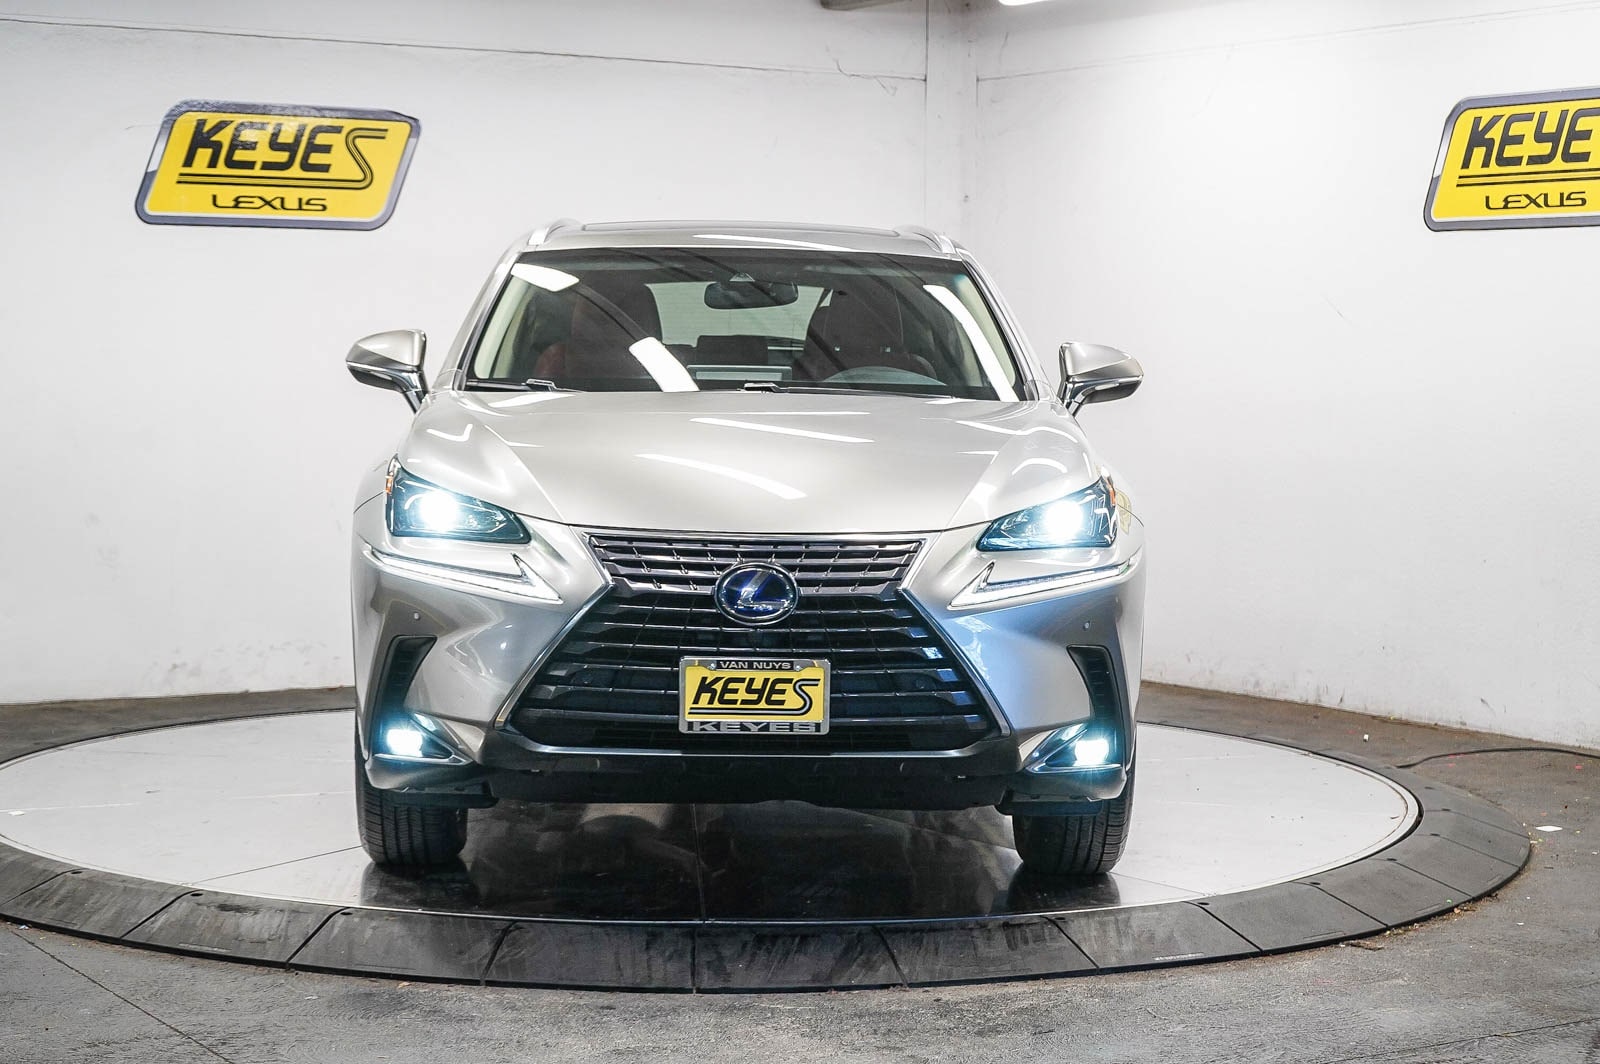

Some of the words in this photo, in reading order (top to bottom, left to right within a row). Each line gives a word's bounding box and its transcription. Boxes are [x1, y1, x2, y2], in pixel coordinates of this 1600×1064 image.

[177, 118, 389, 190] KEYES
[1459, 107, 1600, 180] KEYE
[211, 194, 328, 212] LEXUS
[1484, 190, 1588, 211] LEXUS
[719, 661, 749, 670] VAN
[752, 661, 792, 670] NUYS
[688, 676, 821, 716] KEYES
[692, 722, 816, 733] KEYES
